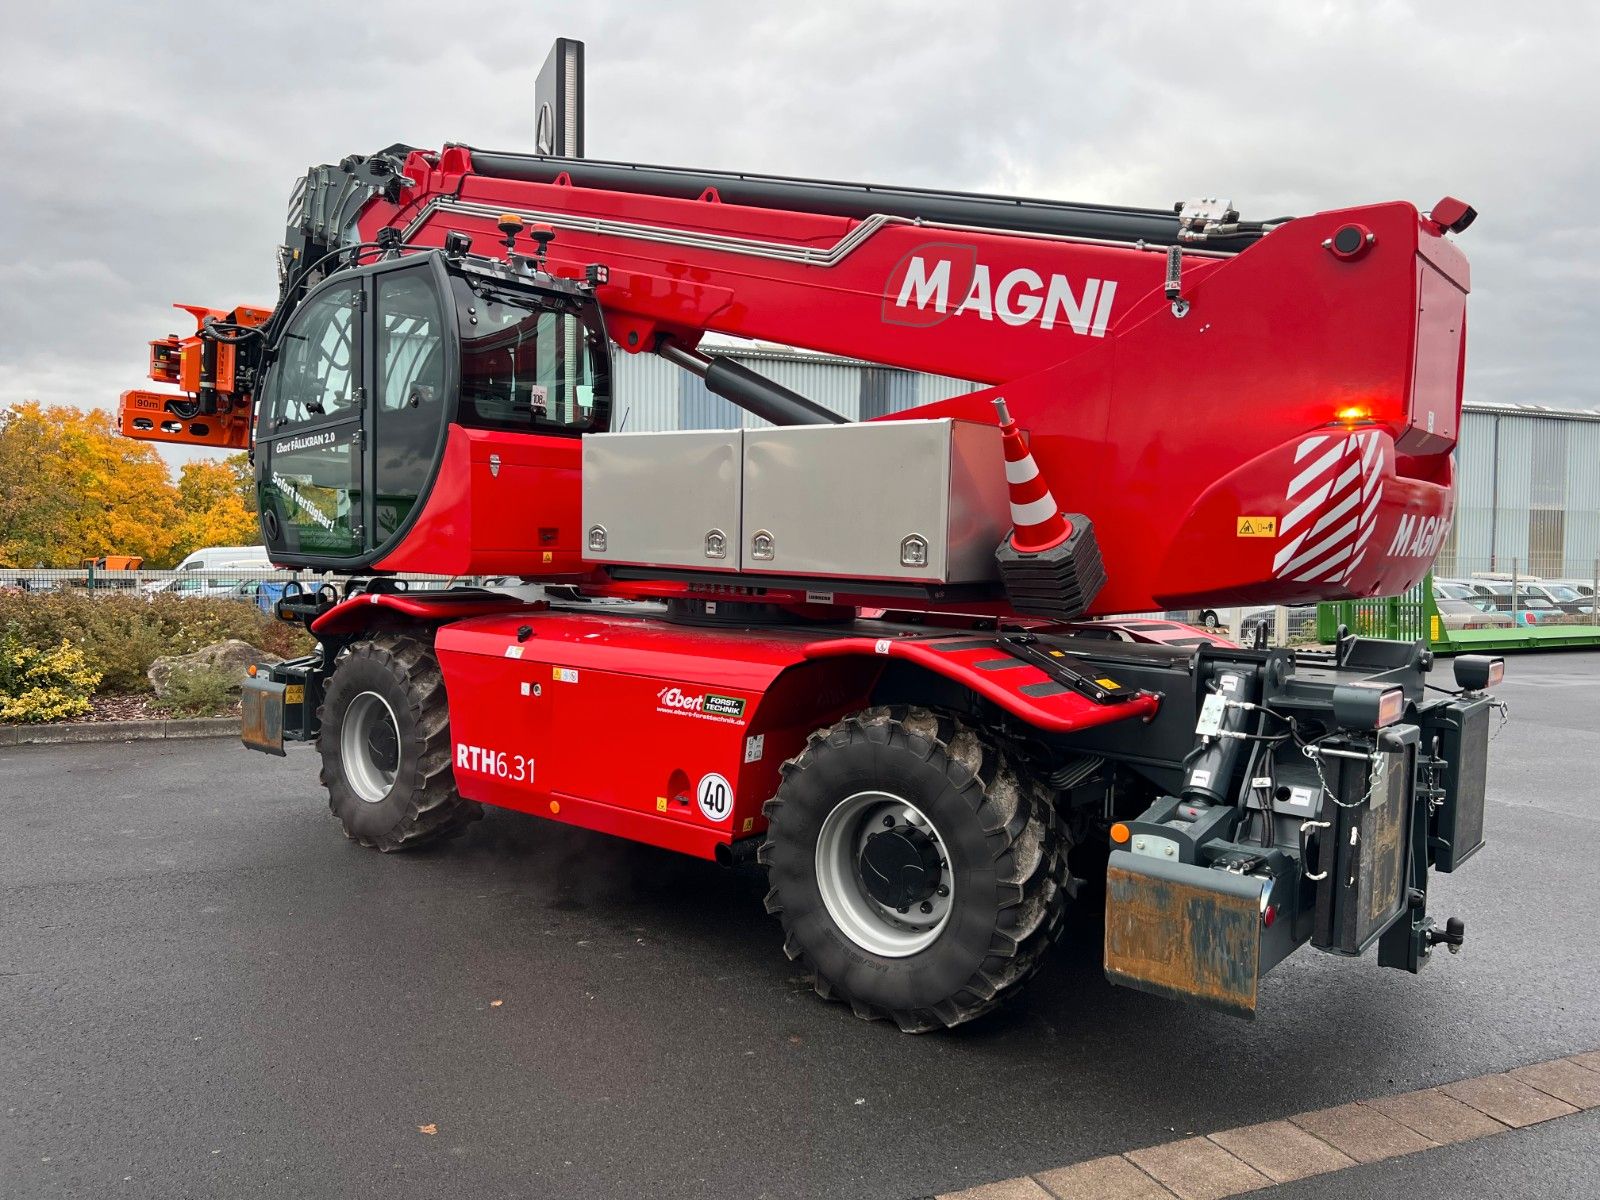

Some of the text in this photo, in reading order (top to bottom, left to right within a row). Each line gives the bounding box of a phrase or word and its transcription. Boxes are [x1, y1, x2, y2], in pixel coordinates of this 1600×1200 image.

[896, 256, 1117, 338] MAGNI
[137, 399, 158, 409] 90m
[324, 432, 335, 443] 2.0
[272, 472, 335, 533] Sofort verfügbar!
[664, 688, 704, 711] Ebert
[706, 703, 739, 715] TECHNIK
[710, 697, 738, 707] FORST-
[656, 706, 746, 726] www.ebert-forsttechnik.de
[704, 781, 725, 813] 40
